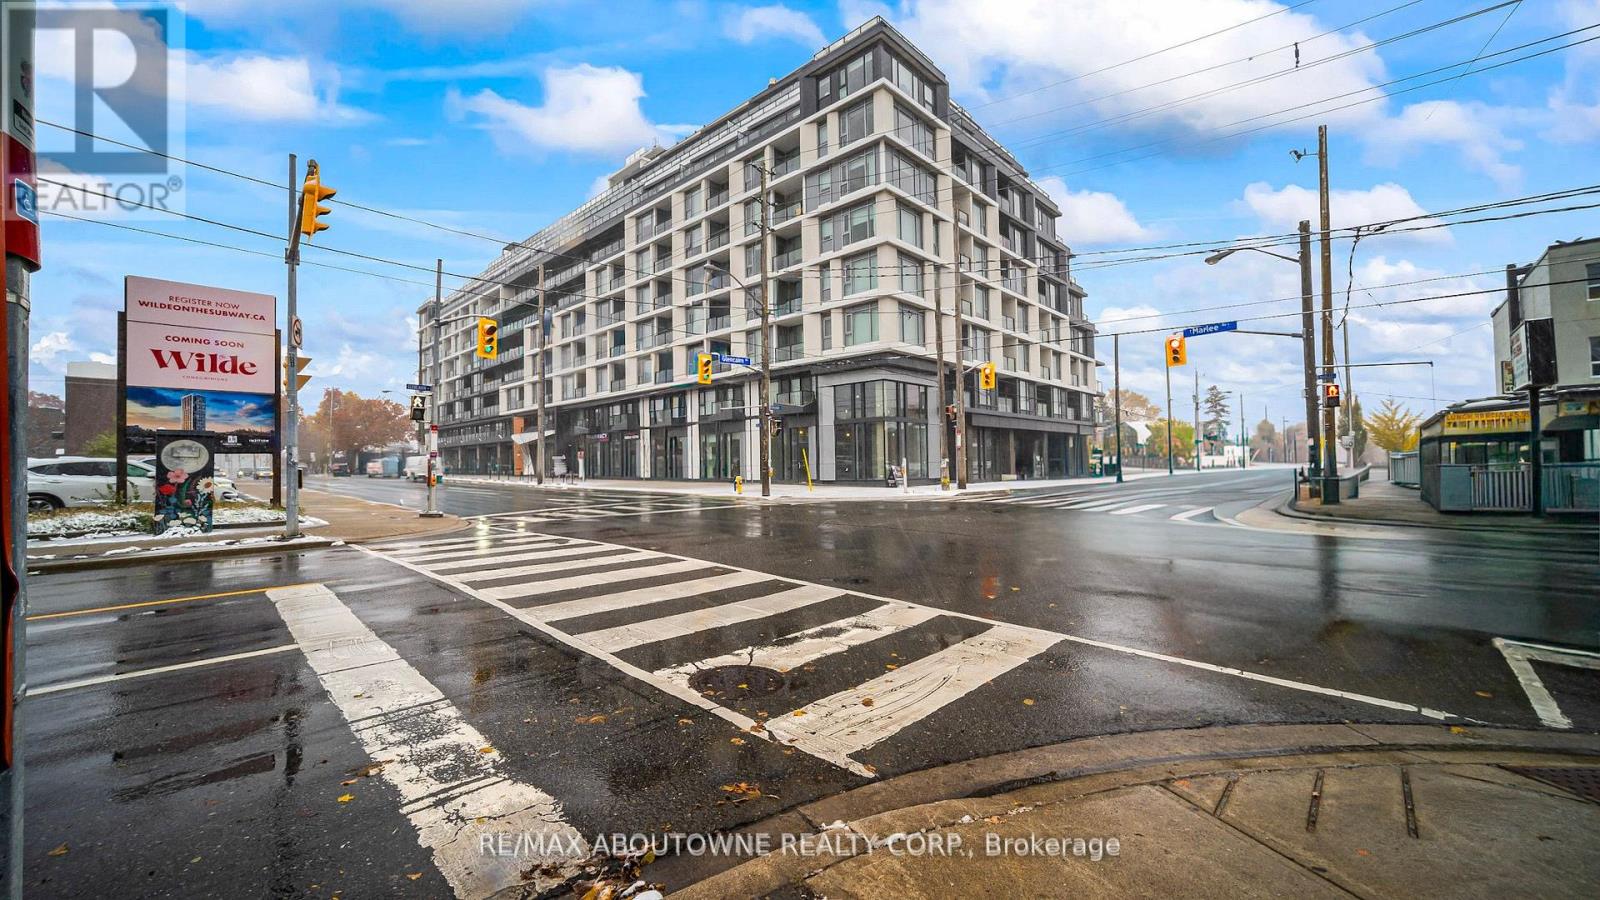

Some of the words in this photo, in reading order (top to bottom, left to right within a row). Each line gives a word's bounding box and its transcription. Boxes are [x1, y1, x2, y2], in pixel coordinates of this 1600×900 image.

[138, 299, 266, 321] WILDEONTHESUBWAY.CA
[168, 295, 212, 308] REGISTER
[215, 301, 240, 310] NOW
[1193, 325, 1219, 334] Marlee
[165, 334, 211, 346] COMING
[214, 339, 245, 349] SOON
[149, 348, 258, 376] Wilde
